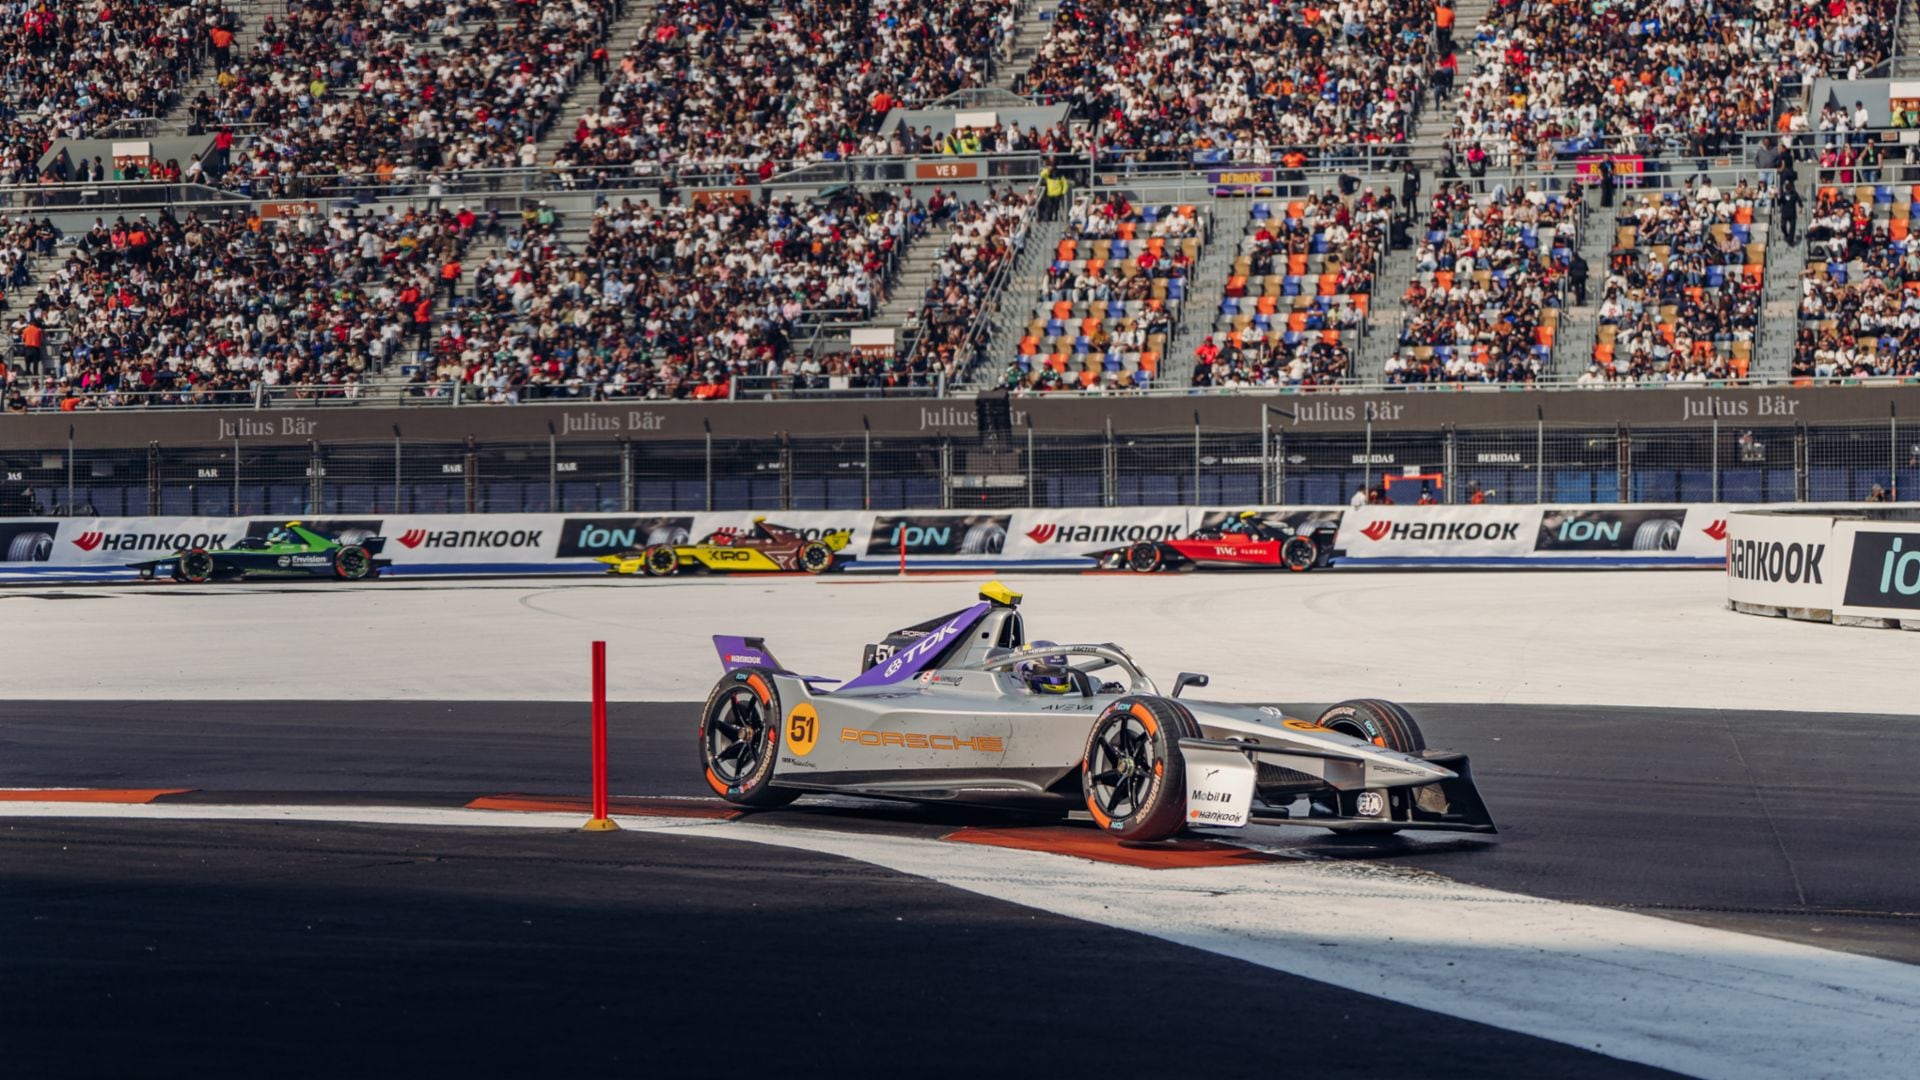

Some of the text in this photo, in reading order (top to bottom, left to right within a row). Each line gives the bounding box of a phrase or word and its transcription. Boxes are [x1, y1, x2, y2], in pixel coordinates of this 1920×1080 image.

[935, 164, 958, 176] VE 9
[1220, 172, 1262, 184] BEBIDAS
[920, 407, 978, 431] Julius
[1293, 400, 1404, 426] Julius Bär
[1683, 395, 1800, 420] Julius Bär
[218, 417, 318, 440] Julius Bär
[562, 411, 666, 435] Julius Bär
[1477, 453, 1520, 463] BEBIDAS
[198, 469, 218, 478] BAR
[292, 555, 328, 563] Envision
[903, 616, 958, 664] TDK
[790, 716, 814, 743] 51
[840, 727, 1004, 753] PORSCHE
[1373, 764, 1426, 777] PORSCHE
[1191, 789, 1232, 803] Mobil 1
